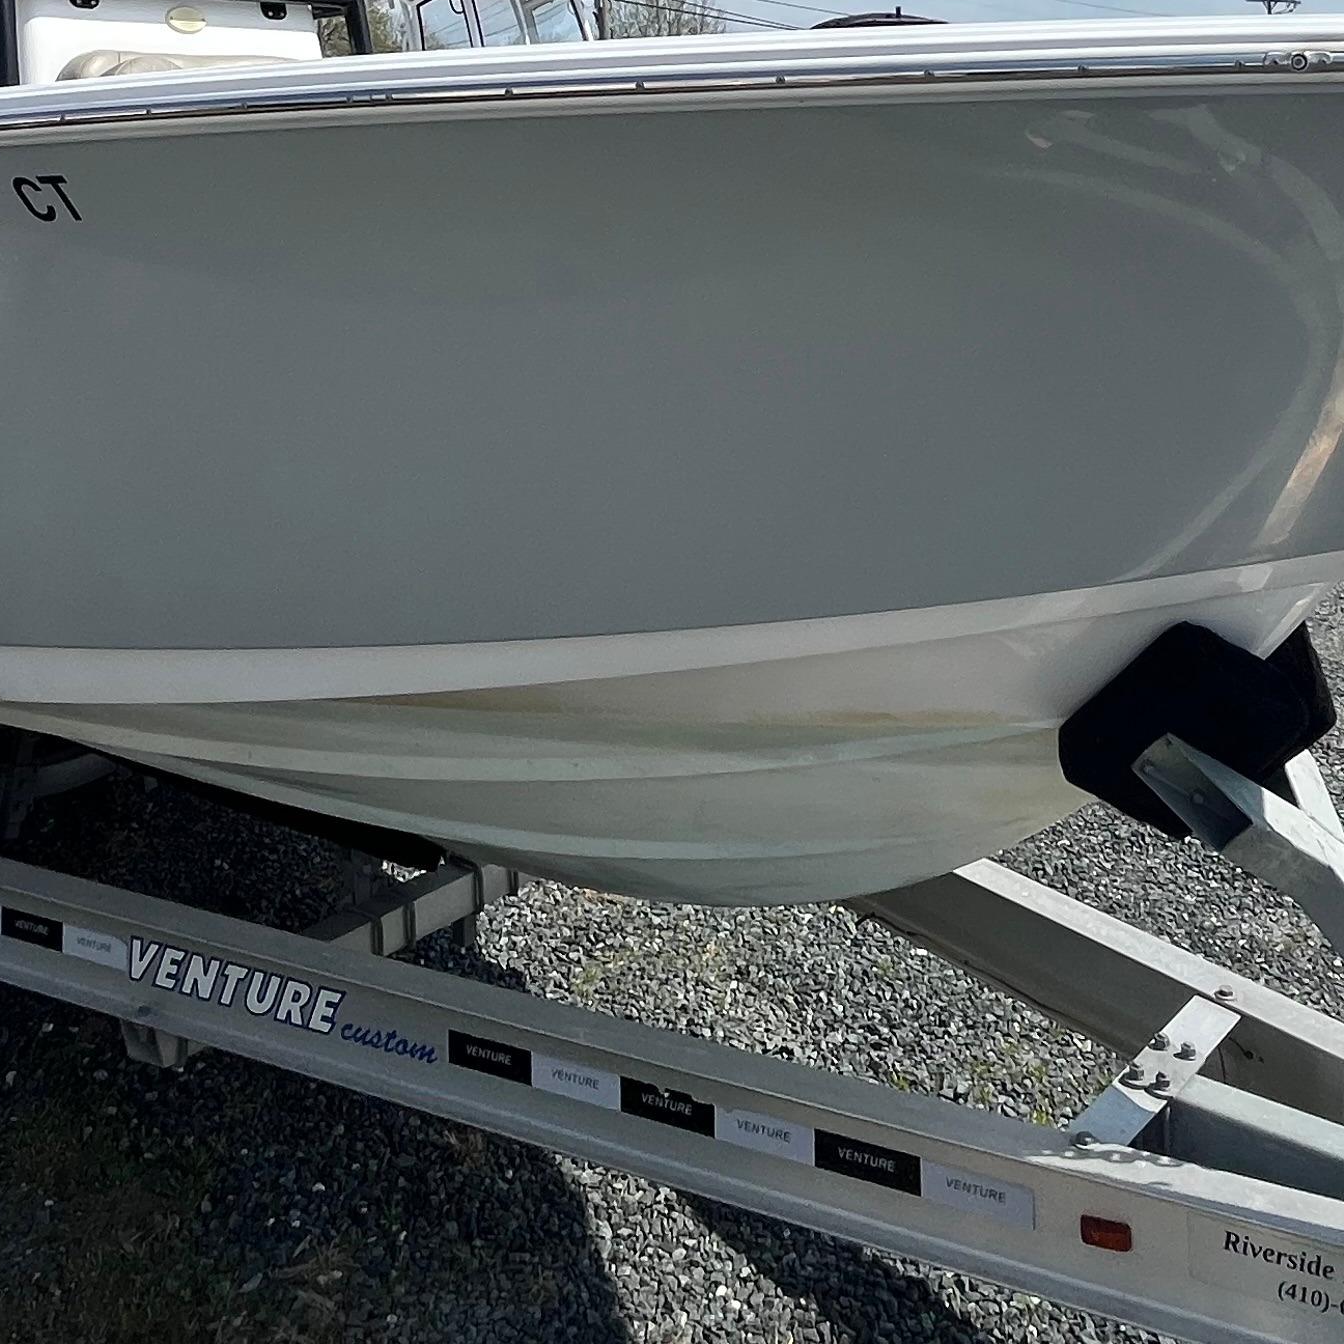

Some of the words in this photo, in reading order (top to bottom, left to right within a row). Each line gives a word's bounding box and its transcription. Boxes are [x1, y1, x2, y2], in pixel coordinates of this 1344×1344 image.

[12, 175, 83, 223] CT
[14, 919, 49, 937] VENTURE
[76, 936, 112, 953] VENTURE
[128, 935, 347, 1035] VENTURE
[340, 1022, 439, 1064] custom
[465, 1043, 512, 1067] VENTURE
[550, 1067, 600, 1091] VENTURE
[640, 1091, 693, 1117] VENTURE
[736, 1118, 792, 1144] VENTURE
[838, 1146, 896, 1173] VENTURE
[944, 1175, 1006, 1204] VENTURE
[1223, 1230, 1335, 1281] Riverside
